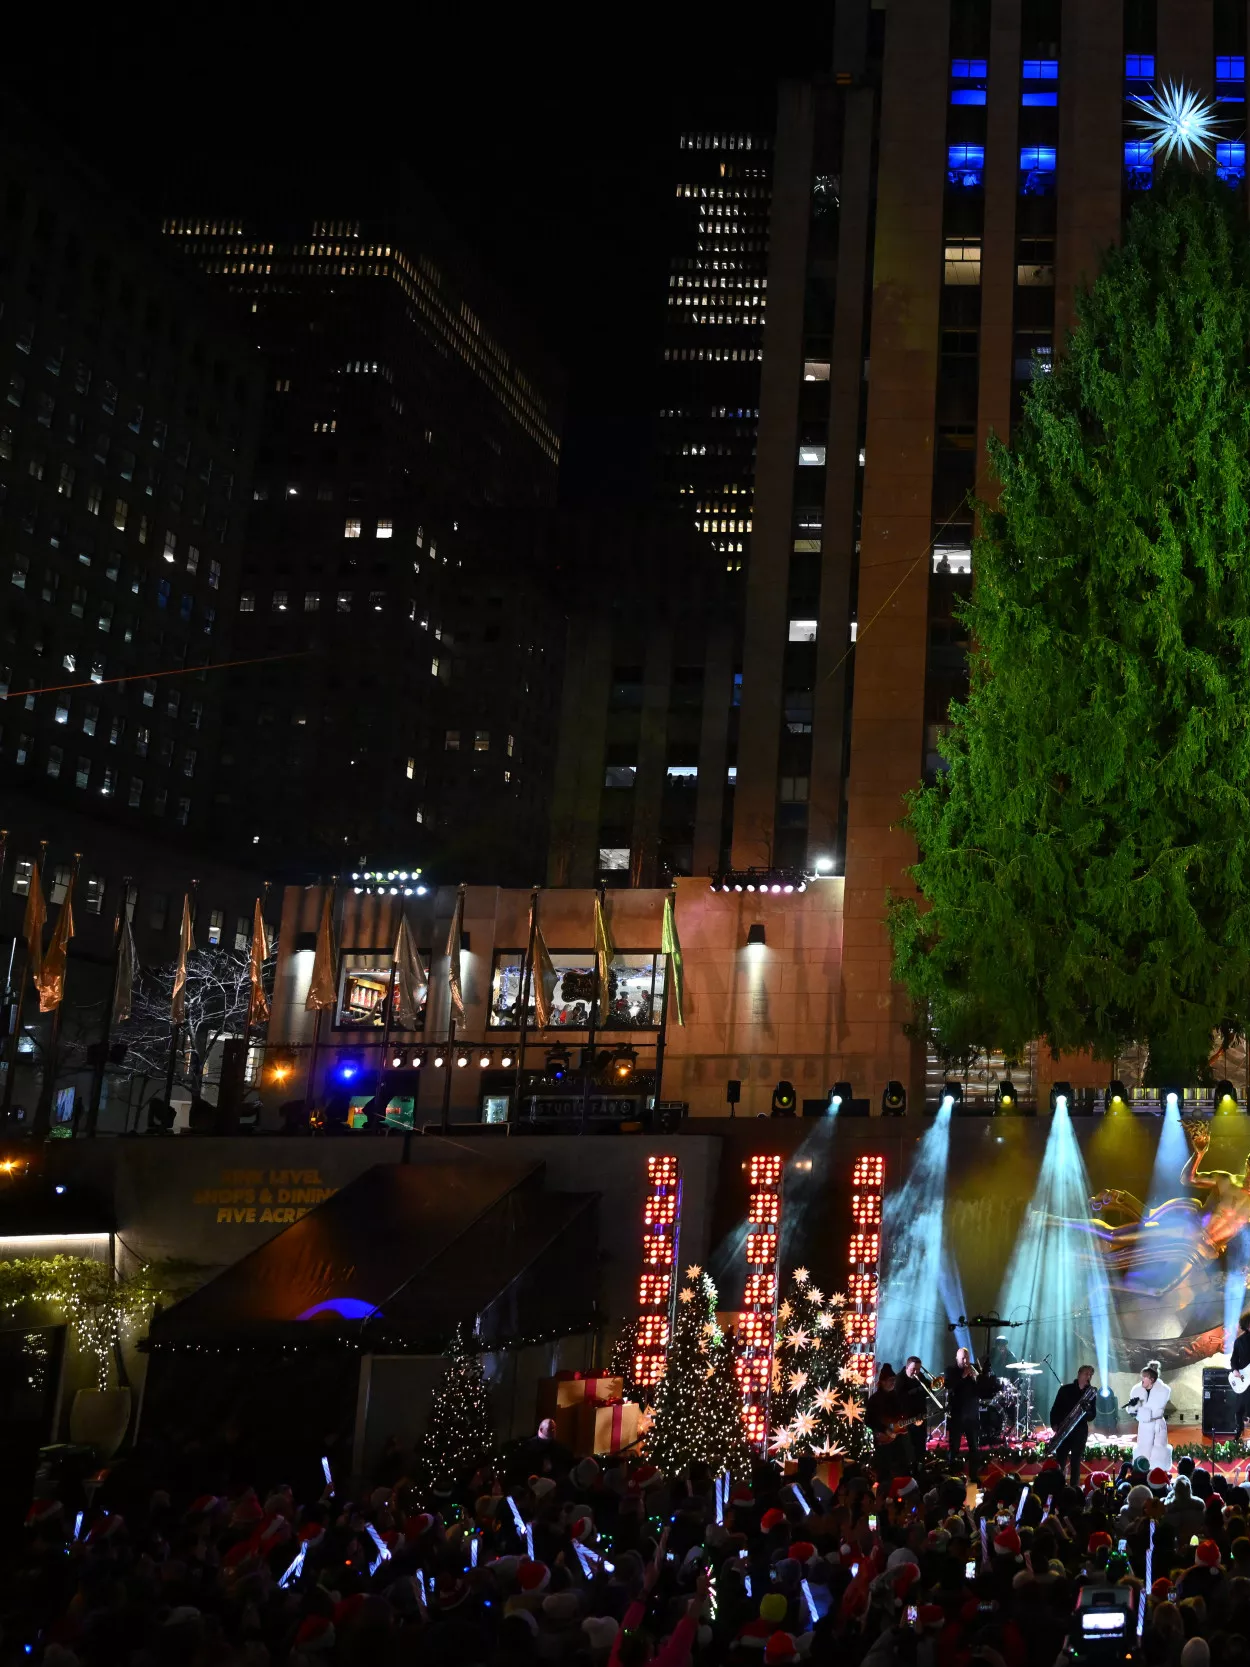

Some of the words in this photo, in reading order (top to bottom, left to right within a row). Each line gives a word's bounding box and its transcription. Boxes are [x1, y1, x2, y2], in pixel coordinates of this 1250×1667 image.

[269, 1168, 323, 1184] LEVEL
[259, 1188, 273, 1204] &
[217, 1207, 257, 1223] FIVE
[259, 1207, 312, 1223] ACRE
